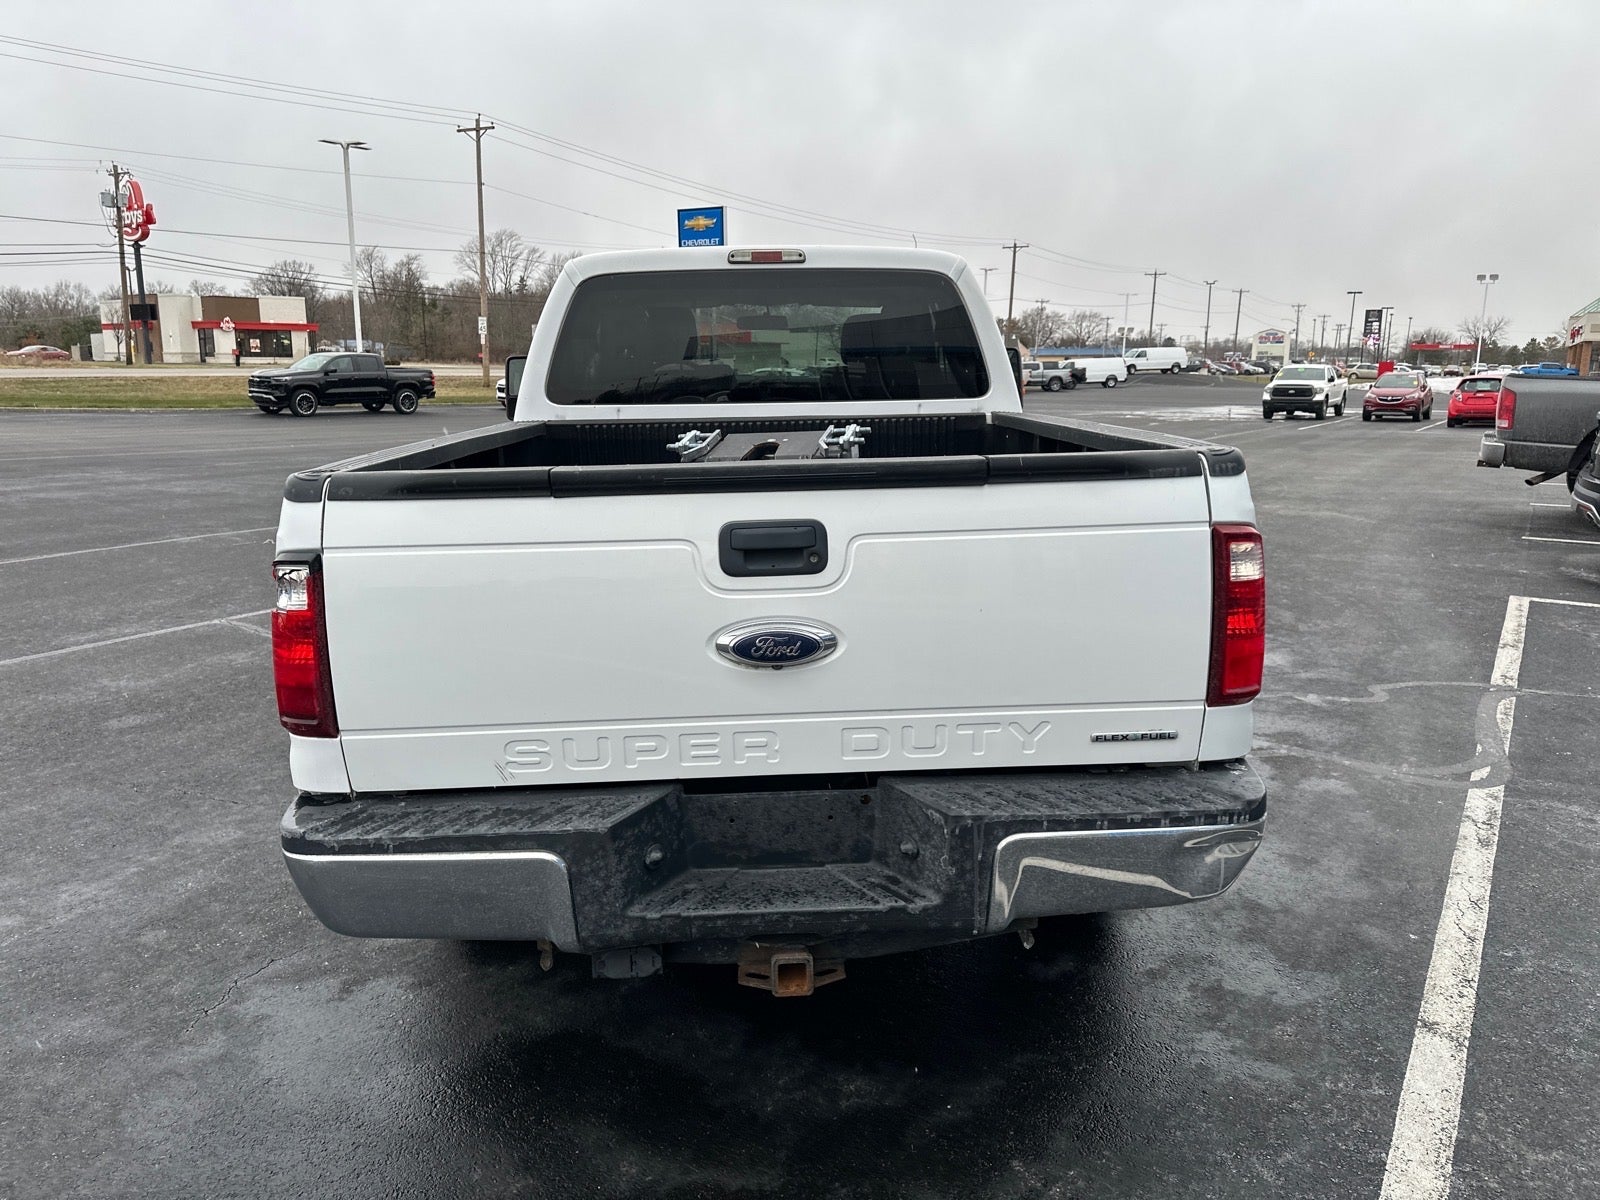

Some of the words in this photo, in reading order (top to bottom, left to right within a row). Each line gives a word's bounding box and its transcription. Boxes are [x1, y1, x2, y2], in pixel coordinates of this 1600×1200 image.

[681, 238, 720, 247] CHEVROLET
[479, 325, 487, 333] 45
[751, 636, 801, 657] Ford
[1095, 733, 1129, 742] FLEX
[1140, 731, 1175, 741] FUEL
[503, 730, 780, 773] SUPER
[841, 720, 1051, 760] DUTY
